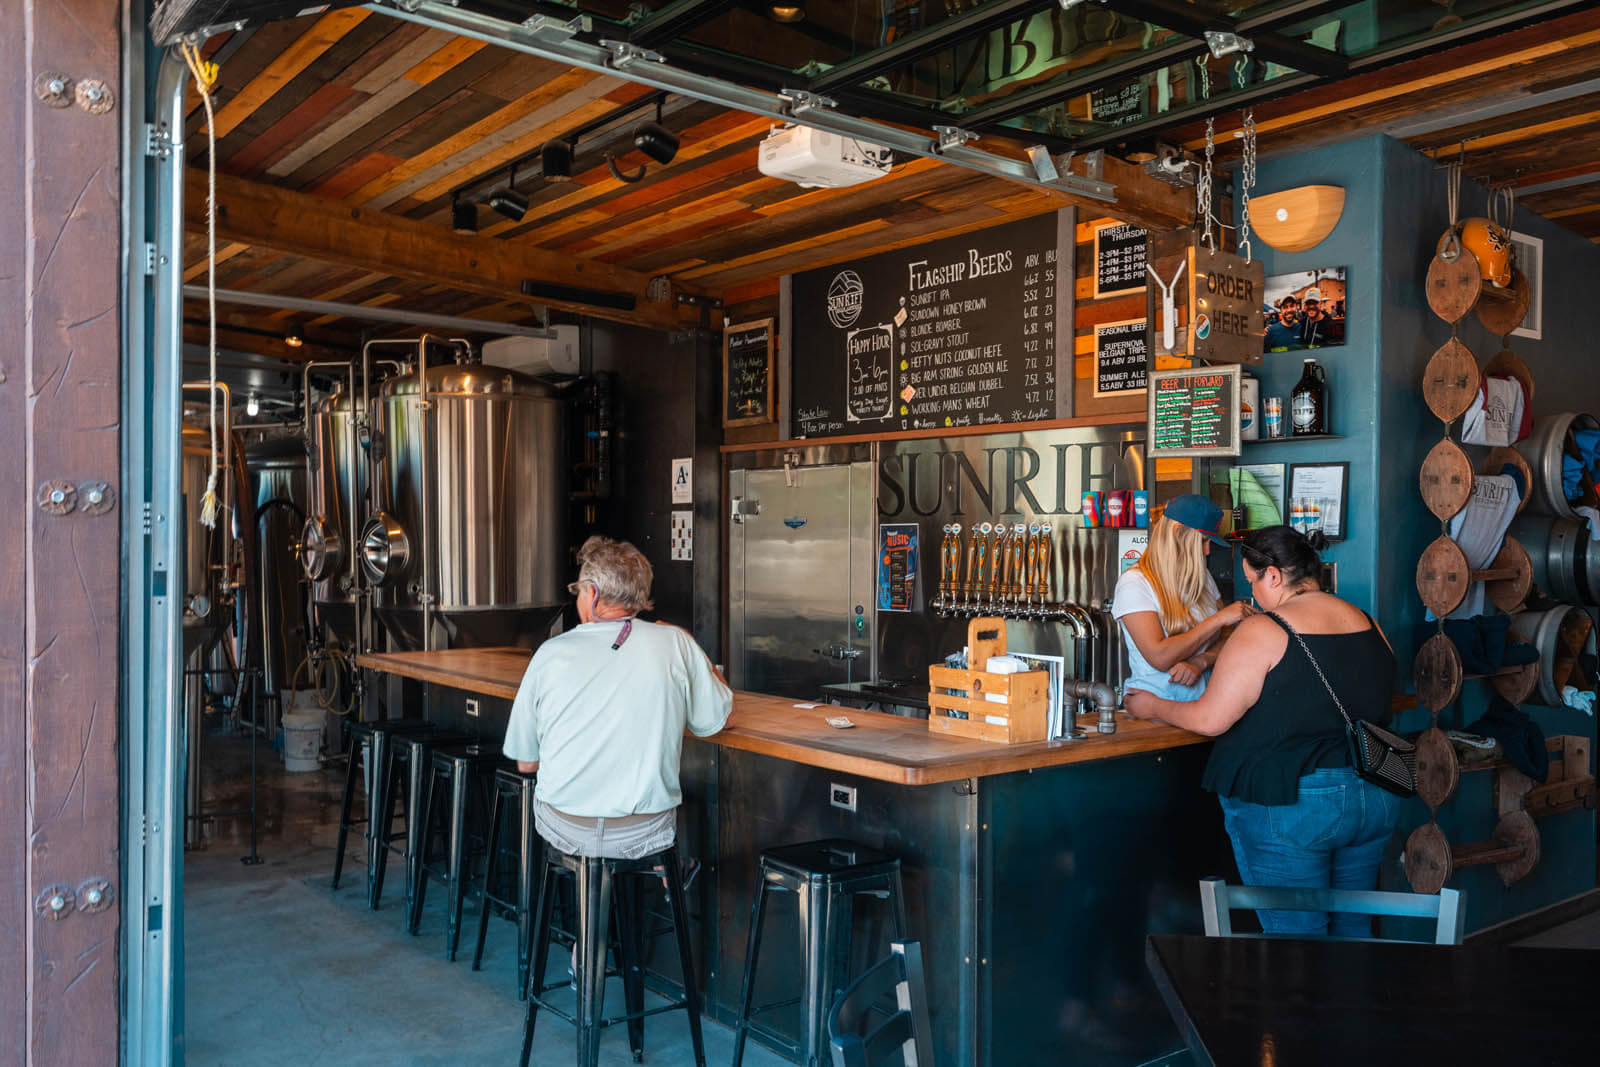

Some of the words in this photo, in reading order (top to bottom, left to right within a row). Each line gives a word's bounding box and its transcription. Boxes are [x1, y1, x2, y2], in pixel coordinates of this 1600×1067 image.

[1100, 225, 1130, 238] THIRSTY
[1133, 243, 1146, 253] PIN
[1133, 252, 1146, 262] PIN
[908, 259, 966, 291] FLAGSHIP
[968, 249, 1014, 280] BEERS
[1133, 261, 1146, 271] PIN
[1133, 269, 1146, 279] PIN
[910, 290, 937, 307] SUNRIFT
[940, 288, 951, 301] IPA
[1045, 269, 1054, 282] 55
[1207, 271, 1254, 303] ORDER
[910, 306, 940, 322] SUNDOWN
[943, 301, 963, 316] HONEY
[964, 297, 987, 312] BROWN
[1045, 286, 1054, 298] 21
[910, 322, 933, 337] BLONDE
[935, 318, 962, 333] BOMBER
[1045, 304, 1053, 316] 23
[1212, 309, 1249, 337] HERE
[1099, 325, 1130, 336] SEASONAL
[850, 337, 871, 355] HAPPY
[872, 334, 890, 351] HOUR
[947, 332, 969, 347] STOUT
[1104, 339, 1144, 351] SUPERNOVA
[910, 354, 933, 369] HEFTY
[934, 351, 952, 365] NUTS
[954, 347, 982, 362] COCONUT
[983, 343, 1003, 358] HEFE
[1045, 337, 1054, 350] 14
[1099, 349, 1126, 359] BELGIAN
[1111, 357, 1125, 366] ABV
[1127, 355, 1136, 364] 29
[910, 371, 921, 384] BIG
[923, 369, 938, 381] ARM
[940, 366, 964, 380] STRONG
[967, 361, 995, 376] GOLDEN
[996, 359, 1008, 373] ALE
[1099, 371, 1129, 382] SUMMER
[1131, 370, 1145, 379] ALE
[874, 381, 888, 393] PINTS
[927, 384, 949, 398] UNDER
[949, 381, 976, 395] BELGIAN
[978, 377, 1005, 391] DUBBEL
[1110, 381, 1124, 390] ABV
[1126, 380, 1136, 389] 33
[1160, 378, 1179, 390] BEER
[1193, 375, 1224, 388] FORWARD
[911, 401, 941, 415] WORKING
[965, 394, 991, 410] WHEAT
[1046, 388, 1054, 401] 12
[676, 465, 686, 484] A
[887, 533, 910, 547] MUSIC
